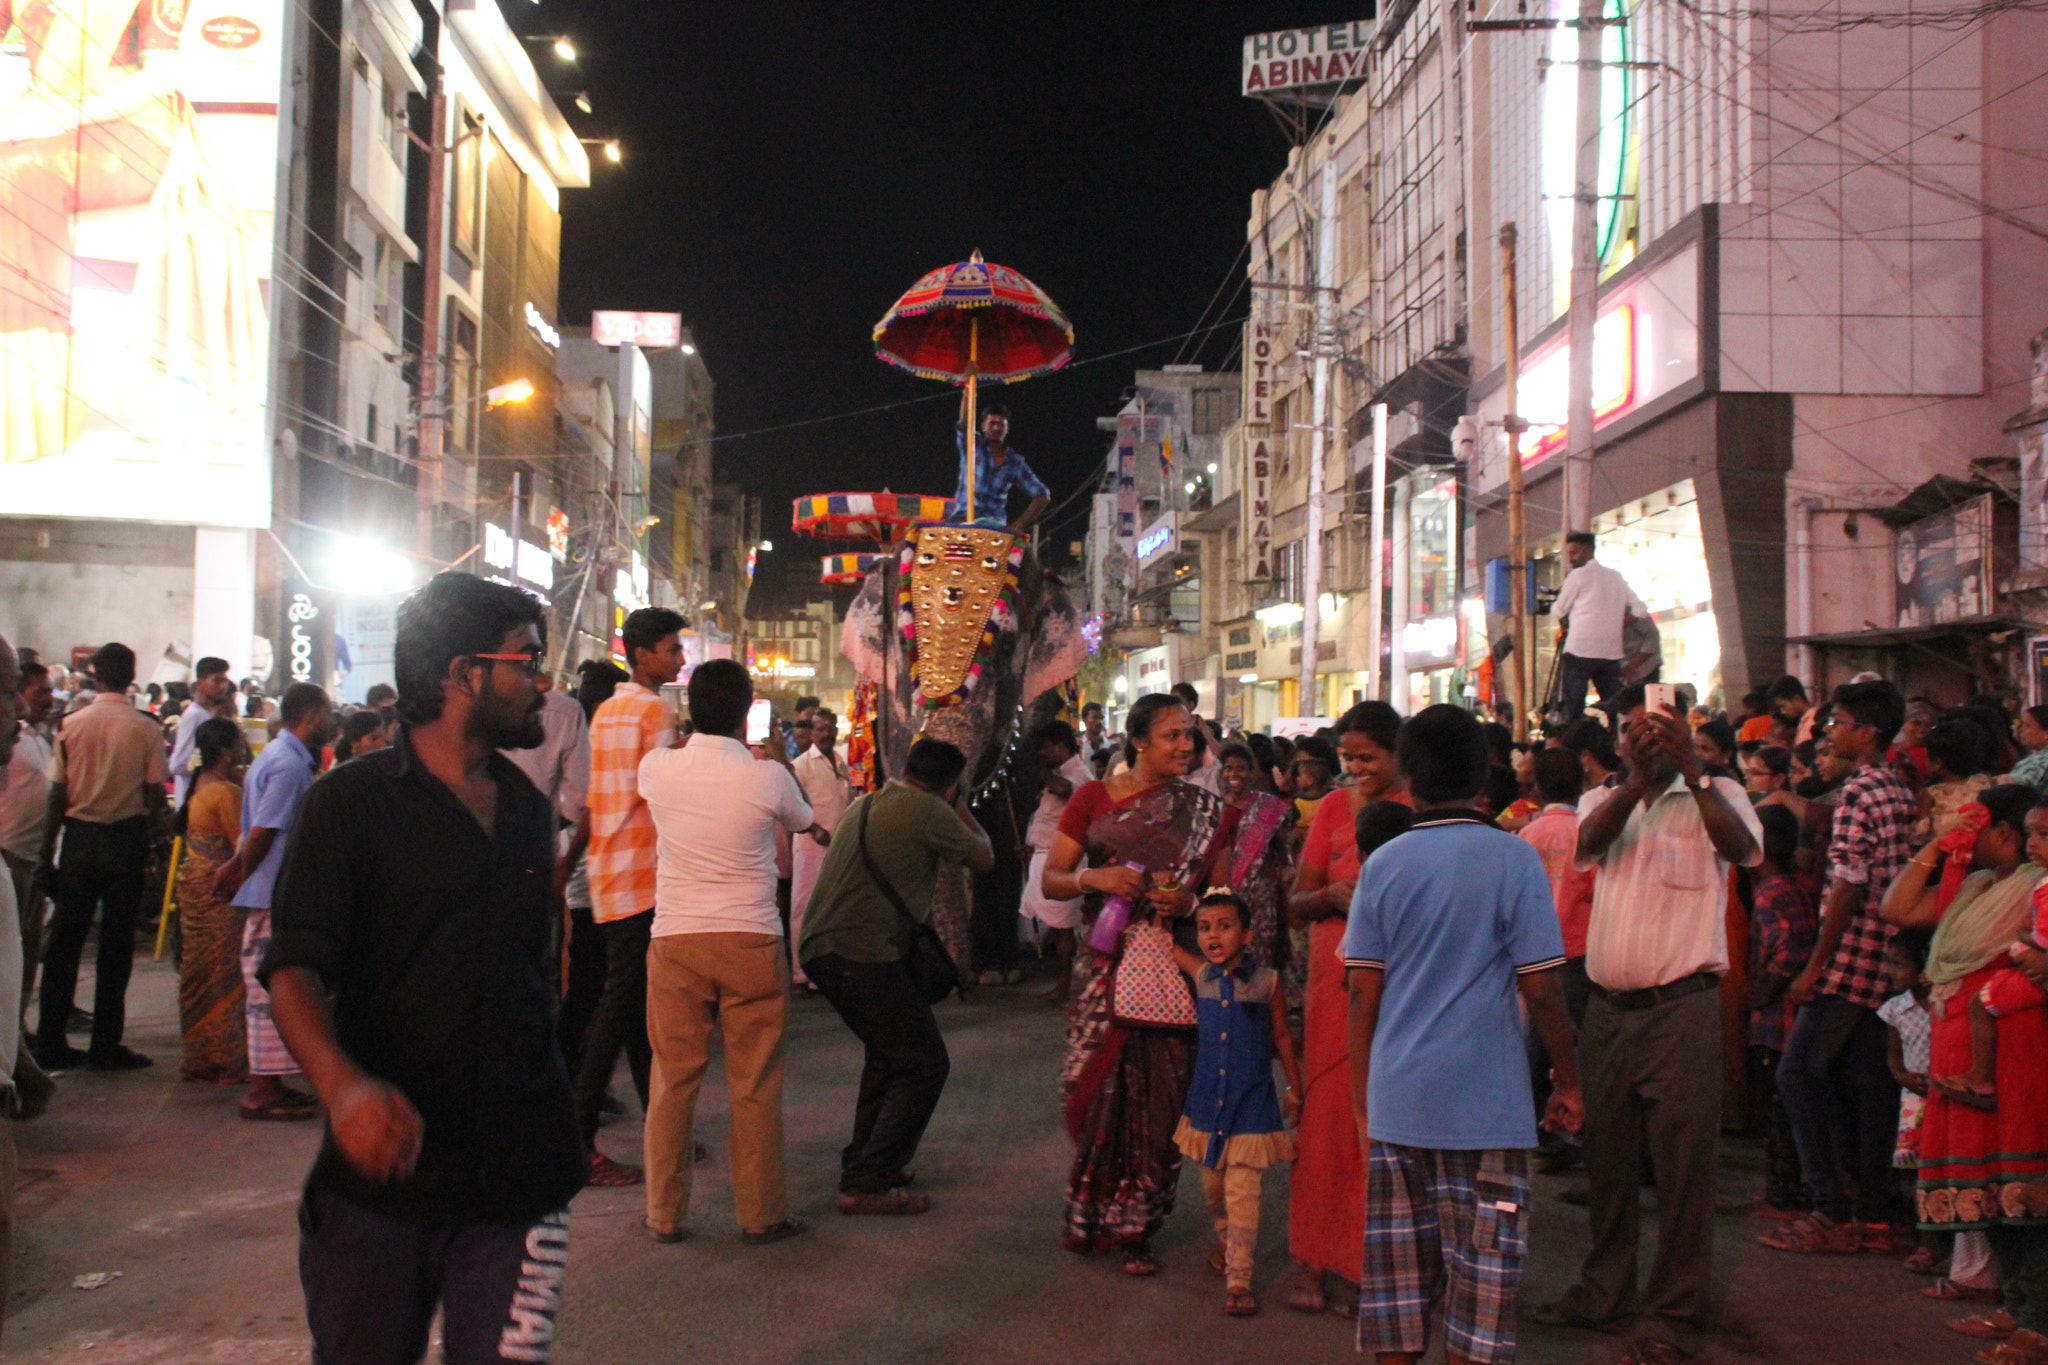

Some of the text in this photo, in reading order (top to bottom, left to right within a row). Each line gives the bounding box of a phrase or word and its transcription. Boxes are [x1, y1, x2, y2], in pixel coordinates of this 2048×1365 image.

[1253, 21, 1370, 60] HOTEL
[1254, 324, 1271, 418] HOTEL
[1254, 441, 1270, 577] ABINAYA
